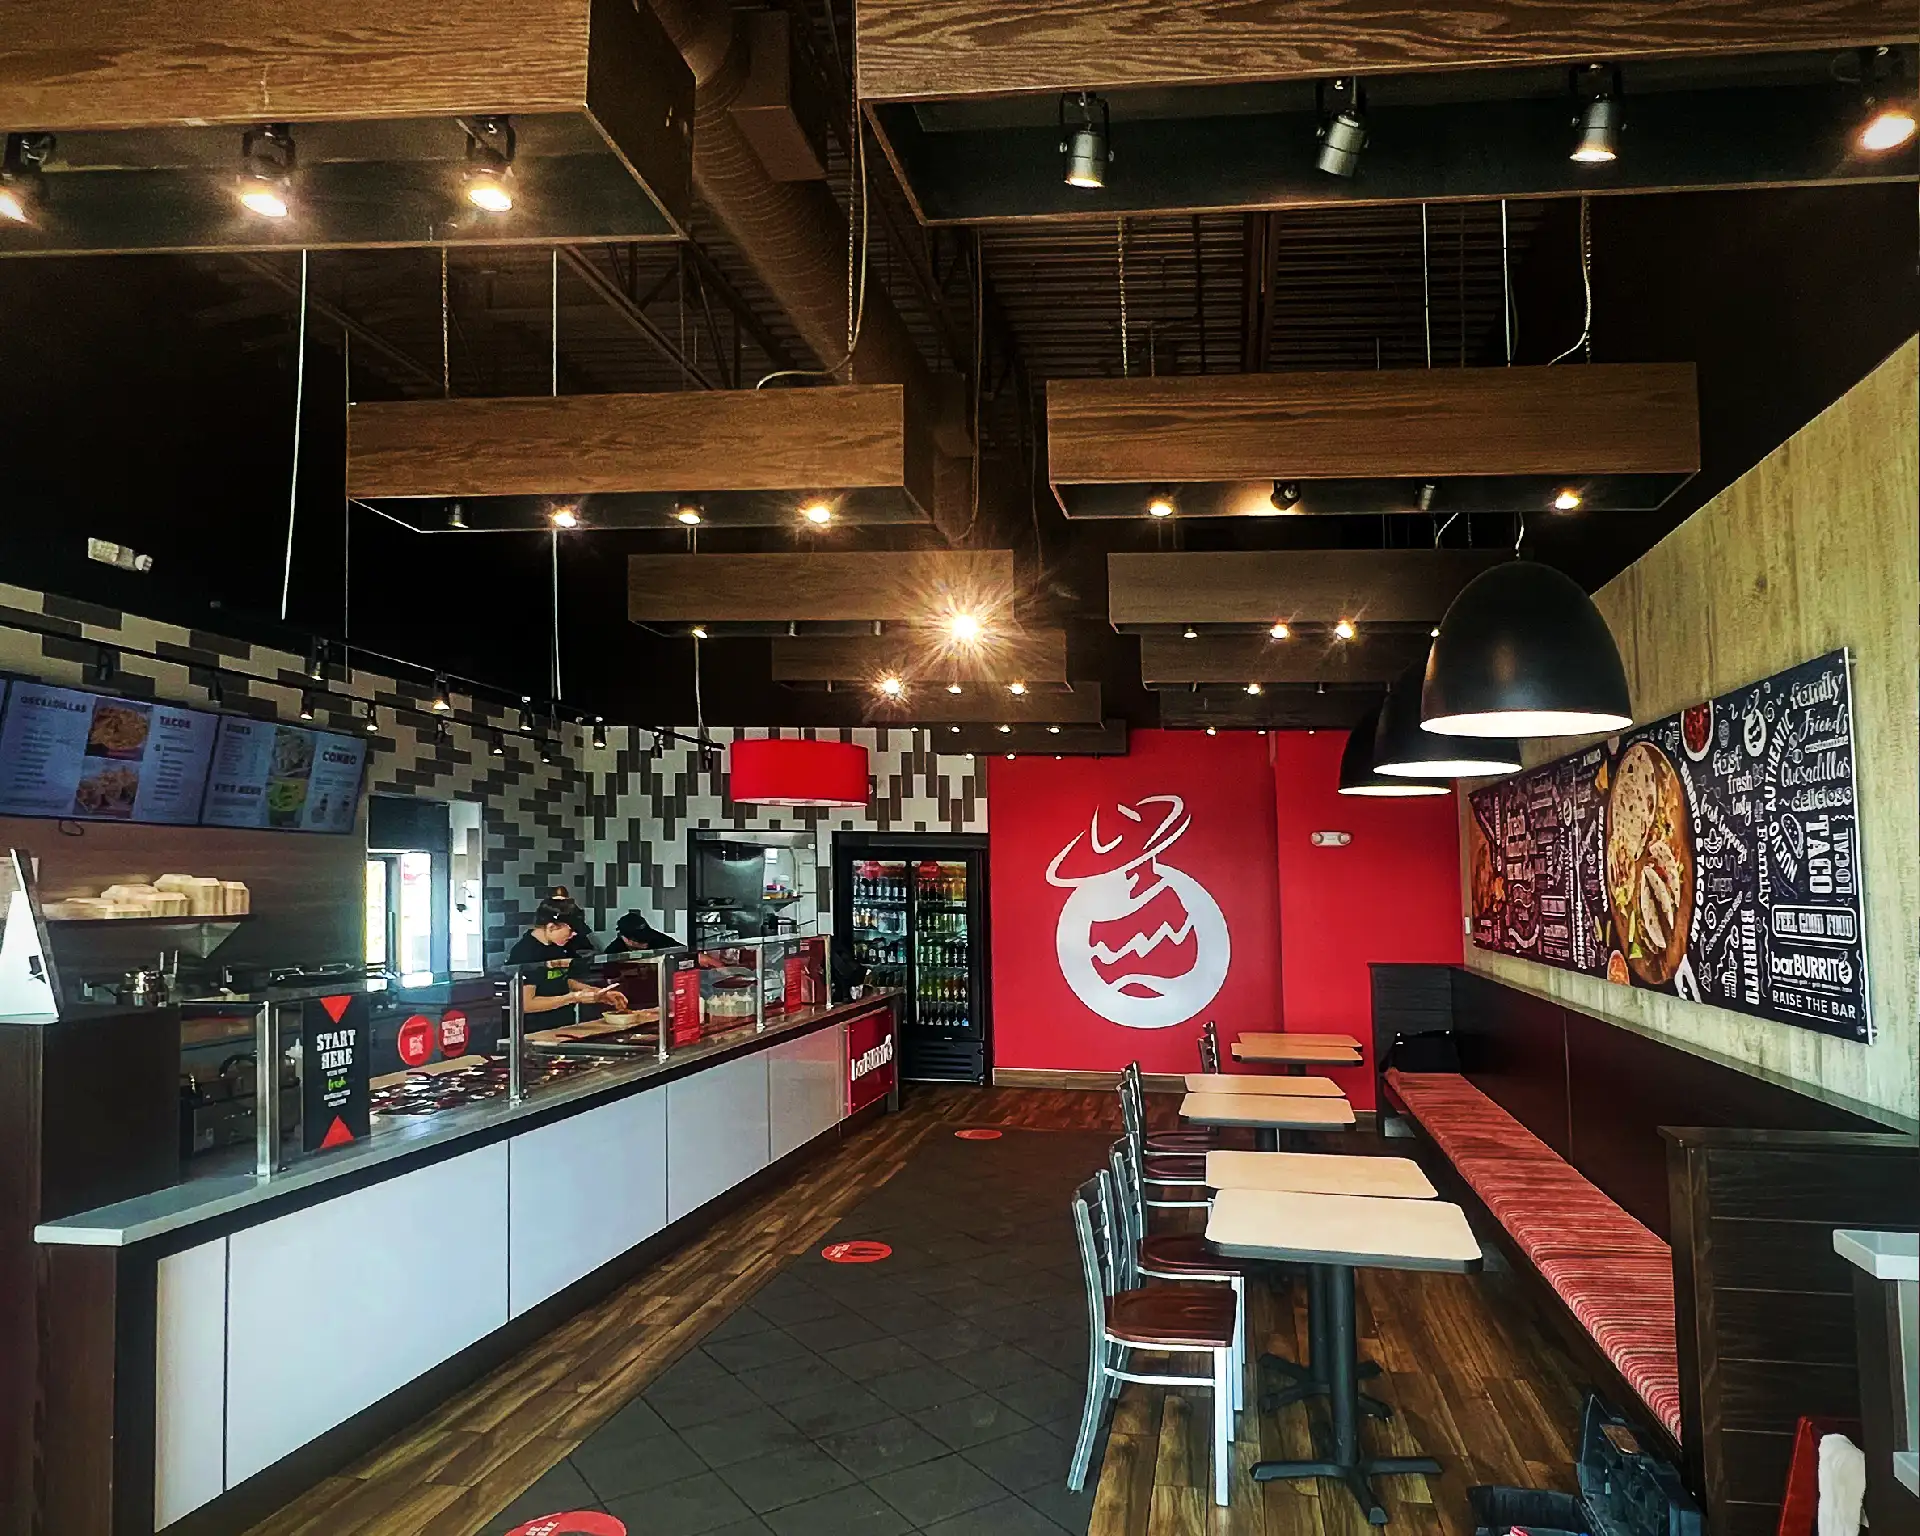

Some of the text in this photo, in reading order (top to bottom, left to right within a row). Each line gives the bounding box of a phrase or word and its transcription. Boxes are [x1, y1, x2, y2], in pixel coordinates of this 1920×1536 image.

[1790, 671, 1844, 709] family
[1799, 704, 1848, 742] Friends
[1781, 751, 1850, 787] Quesadillas
[1764, 709, 1798, 883] NUEVO AUTHENTIC
[1757, 825, 1771, 910] Family
[1806, 815, 1833, 893] TACO
[1833, 828, 1852, 893] LOCAL
[1696, 854, 1705, 906] TACO
[1741, 909, 1760, 1005] BURRITO
[1772, 990, 1856, 1019] RAISE THE BAR
[316, 1029, 356, 1052] START
[321, 1048, 353, 1069] HERE
